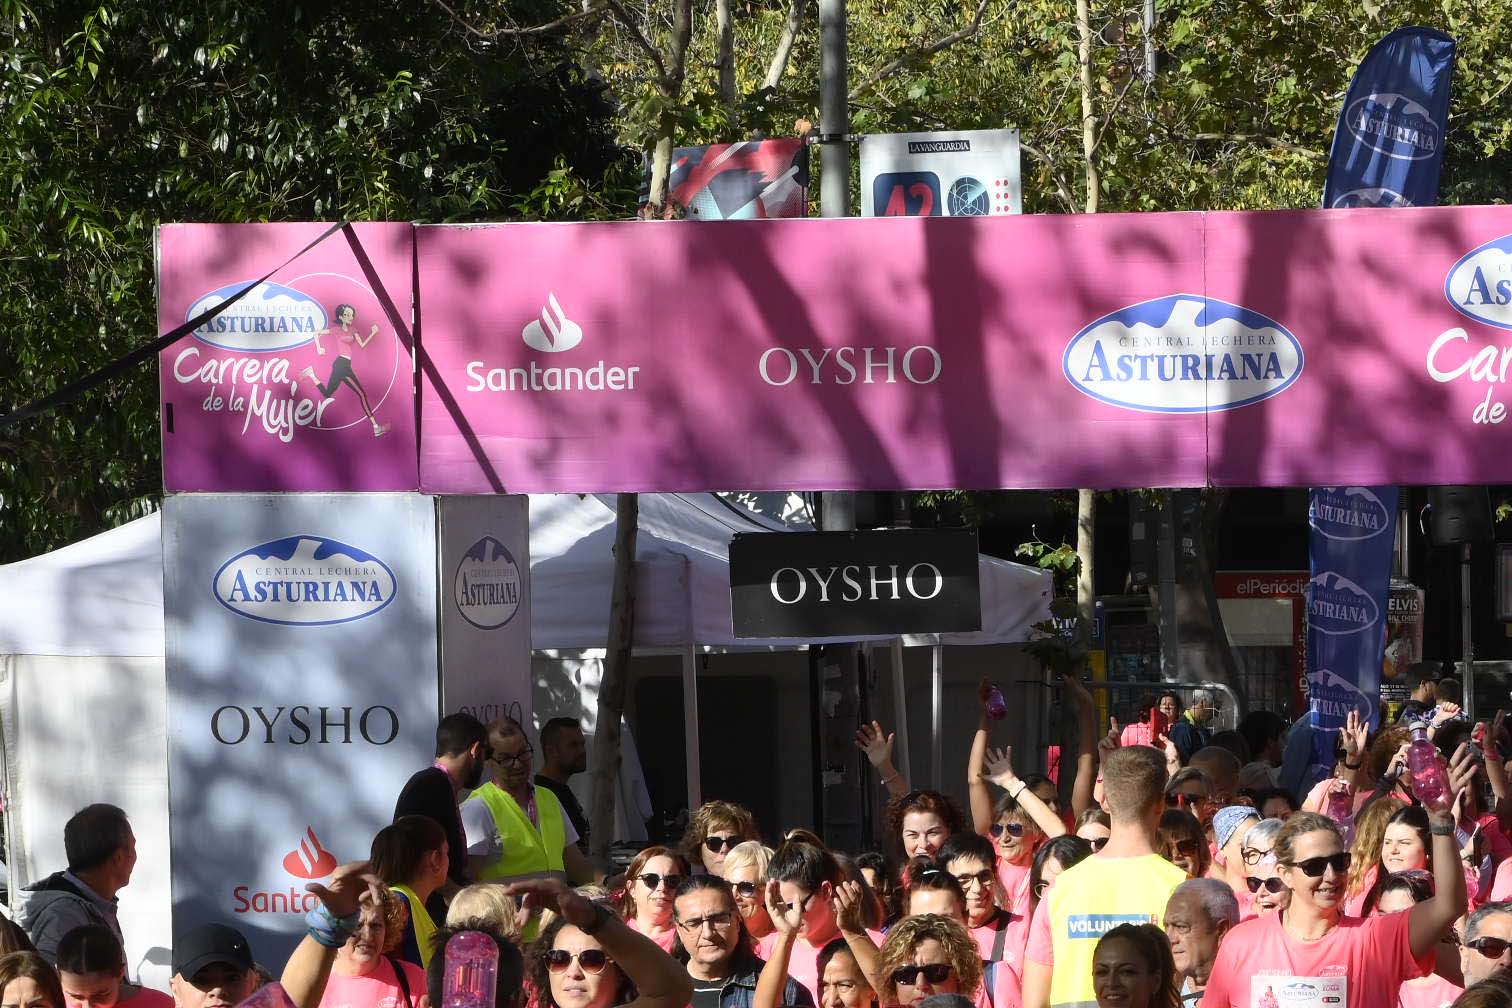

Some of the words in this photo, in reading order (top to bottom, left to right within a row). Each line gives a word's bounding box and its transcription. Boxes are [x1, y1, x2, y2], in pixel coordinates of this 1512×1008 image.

[197, 306, 316, 333] ASTURIANA
[1119, 336, 1194, 347] CENTRAL
[1201, 334, 1277, 346] LECHERA
[174, 346, 291, 383] Carrera
[467, 361, 640, 392] Santander
[759, 346, 942, 386] OYSHO
[1082, 339, 1285, 382] ASTURIANA
[202, 386, 223, 411] de
[228, 386, 244, 411] la
[242, 381, 335, 442] Mujer
[1472, 385, 1507, 425] de
[228, 569, 384, 602] ASTURIANA
[255, 567, 313, 576] CENTRAL
[319, 567, 377, 576] LECHERA
[770, 562, 943, 605] OYSHO
[1236, 578, 1307, 594] elPeriódi
[459, 571, 518, 607] ASTURIANA
[1388, 599, 1419, 611] ELVIS
[210, 705, 400, 745] OYSHO
[234, 886, 318, 913] Santa
